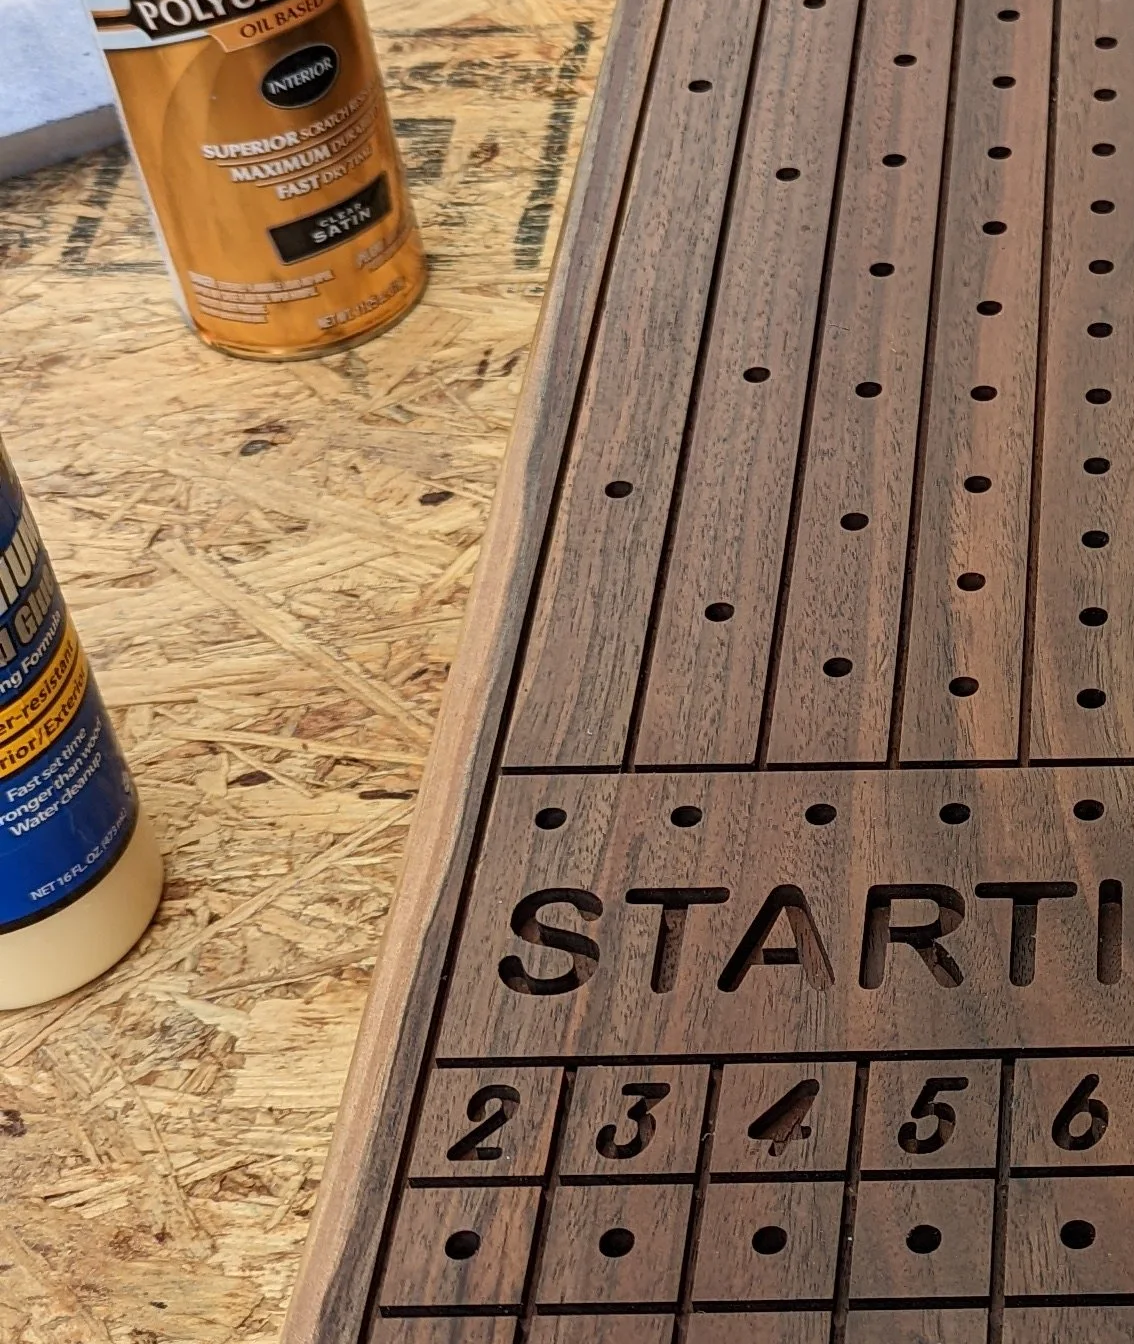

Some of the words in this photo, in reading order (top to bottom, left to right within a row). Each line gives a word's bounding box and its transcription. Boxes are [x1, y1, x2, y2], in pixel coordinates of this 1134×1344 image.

[240, 19, 274, 40] OIL
[267, 56, 334, 95] INTERIOR
[202, 131, 300, 160] SUPERIOR
[298, 109, 349, 141] SCRATCH
[230, 146, 332, 183] MAXIMUM
[275, 173, 321, 201] FAST
[312, 208, 371, 244] SATIN
[319, 203, 362, 227] CLEAR
[21, 609, 62, 674] Formula
[6, 775, 42, 802] Fast
[41, 759, 65, 780] set
[62, 727, 87, 759] time
[54, 758, 84, 790] than
[10, 802, 60, 837] Water
[61, 751, 101, 805] cleanup
[30, 882, 57, 901] NET
[57, 871, 73, 887] 16
[447, 1084, 521, 1162] 2
[596, 1082, 671, 1160] 3
[748, 1078, 821, 1157] 4
[898, 1076, 969, 1154] 5
[1051, 1073, 1110, 1152] 6
